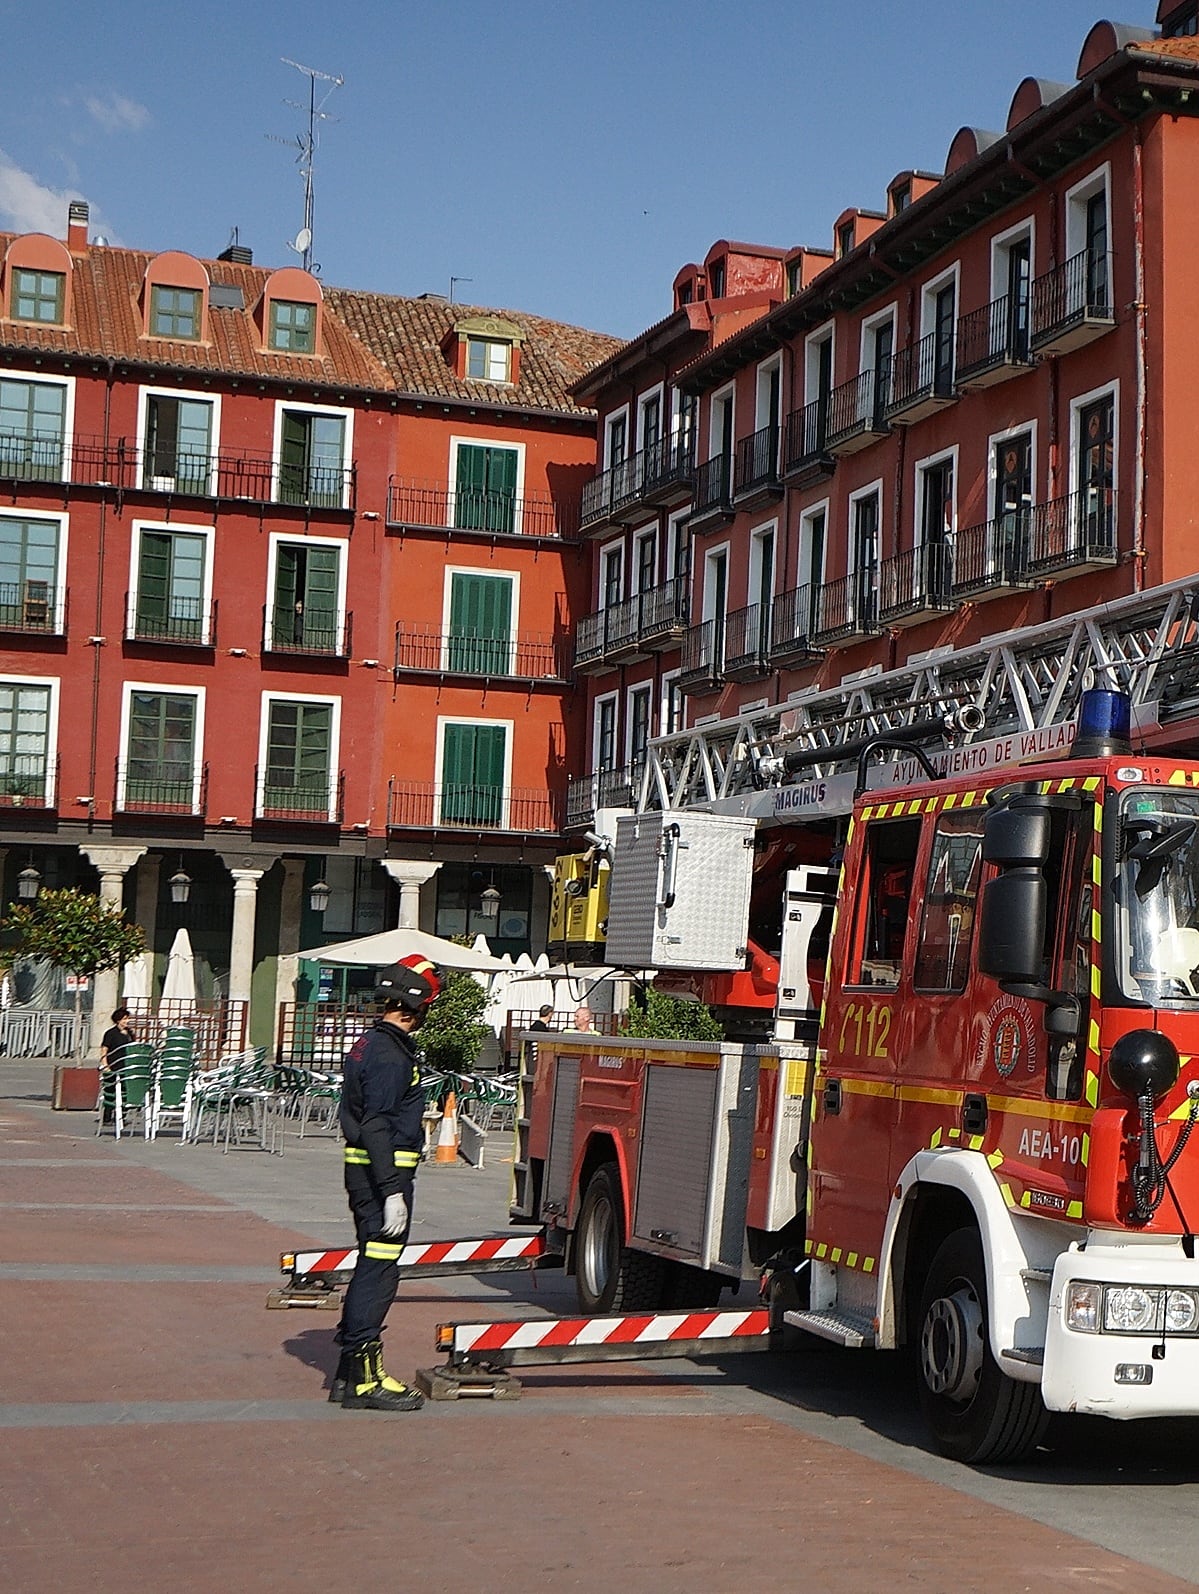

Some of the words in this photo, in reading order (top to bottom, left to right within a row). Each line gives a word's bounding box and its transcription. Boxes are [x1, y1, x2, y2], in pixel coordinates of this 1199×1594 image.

[893, 747, 987, 782] AYUNAMIENTO
[995, 740, 1012, 763] DE
[1020, 723, 1076, 757] VALLAD
[775, 783, 827, 810] MAGIRUS
[855, 1005, 891, 1058] 112
[1018, 1127, 1080, 1165] AEA-10
